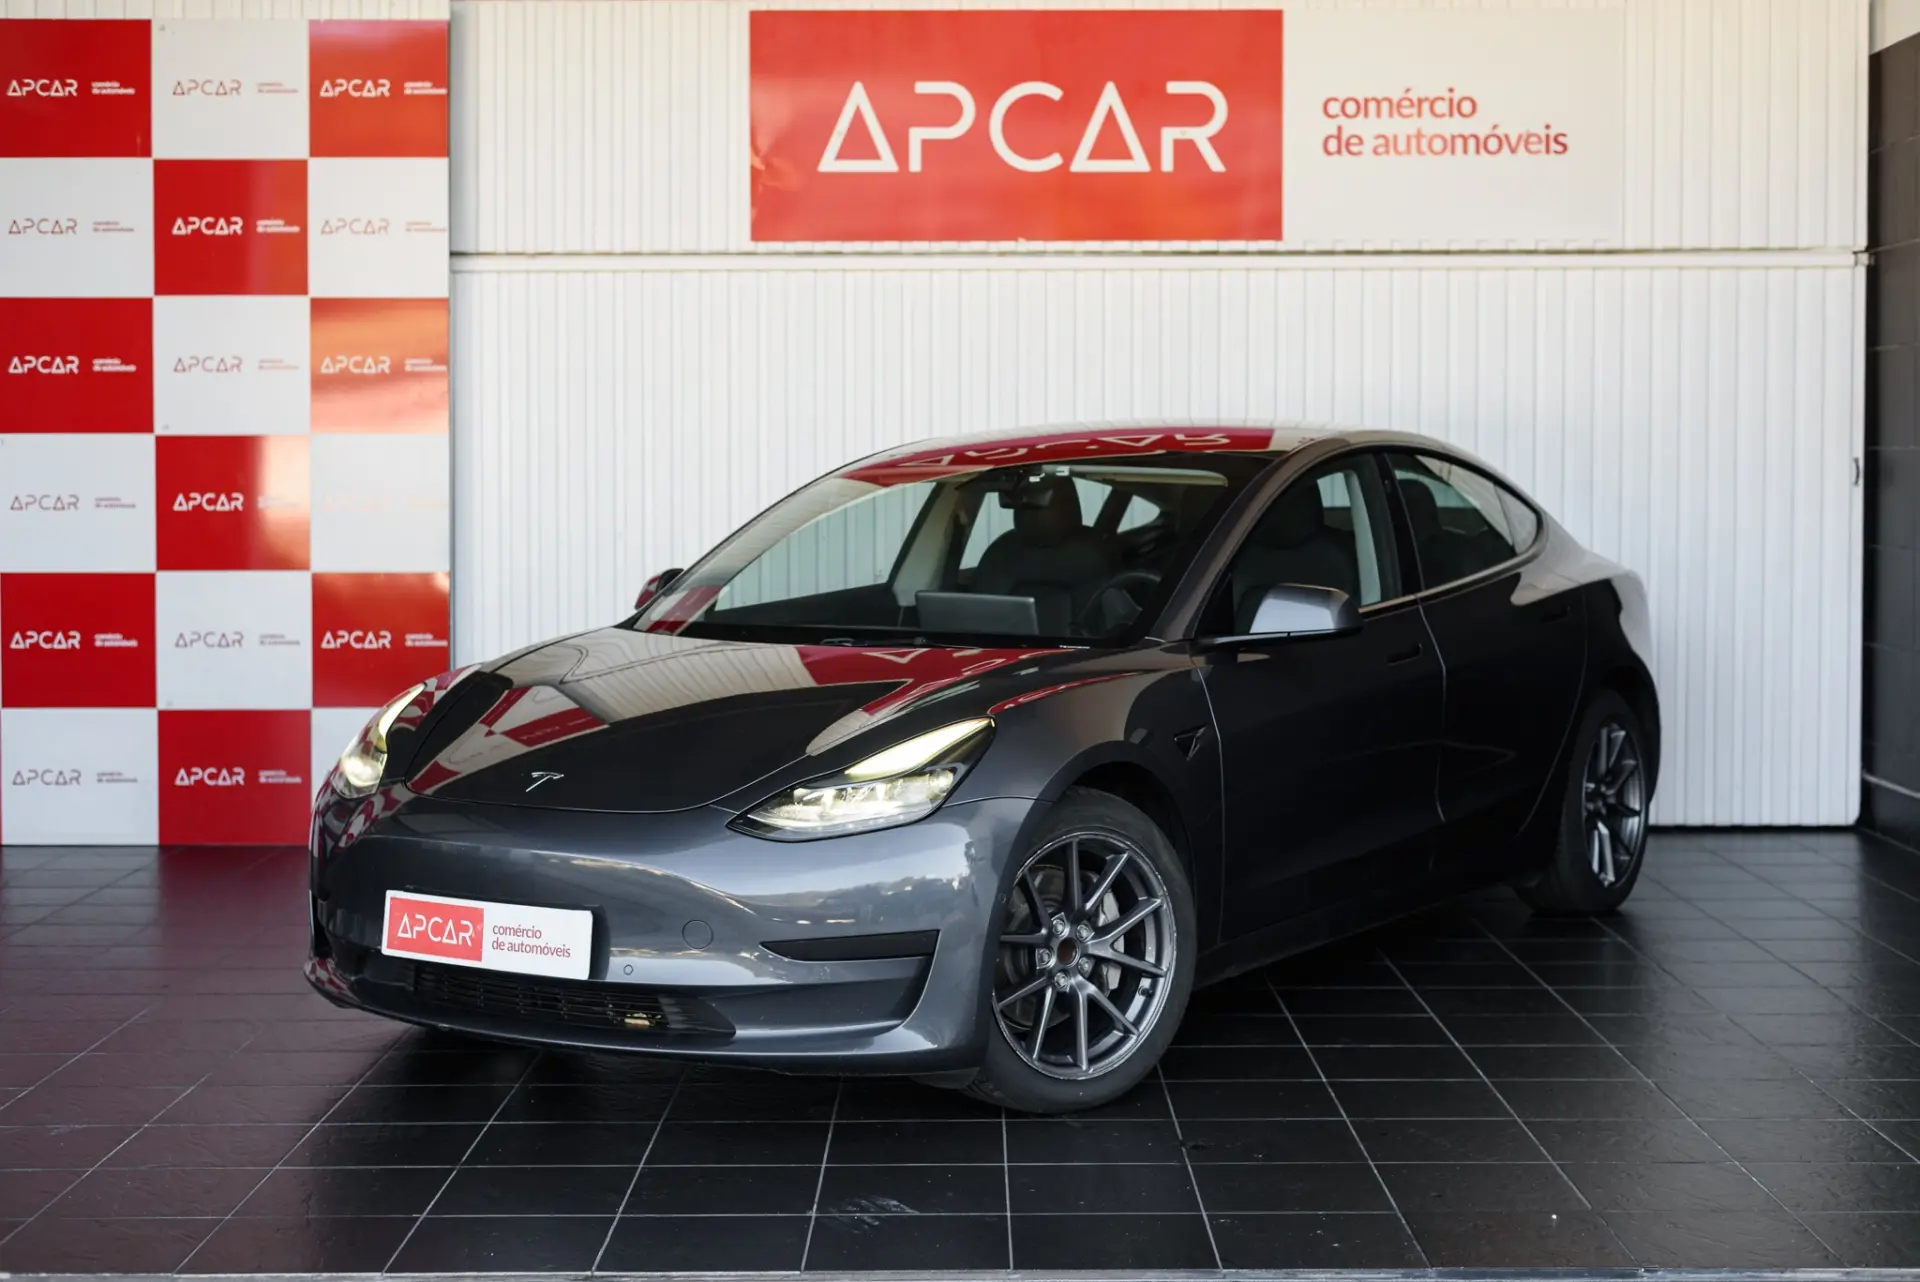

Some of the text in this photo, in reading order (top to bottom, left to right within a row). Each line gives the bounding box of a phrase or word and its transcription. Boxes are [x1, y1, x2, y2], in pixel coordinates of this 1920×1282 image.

[7, 79, 78, 97] APCAR
[172, 79, 242, 97] APCAR
[320, 79, 390, 97] APCAR
[1322, 87, 1478, 119] comércio
[817, 81, 1228, 174] APCAR
[1322, 123, 1569, 157] de automóveis
[8, 218, 77, 235] APCAR
[172, 217, 243, 235] APCAR
[320, 218, 390, 235] APCAR
[8, 356, 79, 374] APCAR
[173, 356, 242, 373] APCAR
[320, 355, 391, 374] APCAR
[10, 494, 79, 511] APCAR
[173, 492, 244, 511] APCAR
[10, 631, 81, 649] APCAR
[175, 631, 244, 648] APCAR
[321, 630, 391, 649] APCAR
[12, 769, 81, 786] APCAR
[175, 767, 245, 786] APCAR
[397, 912, 473, 947] APCAR
[492, 923, 542, 940] comércio
[491, 937, 571, 958] de automóveis
